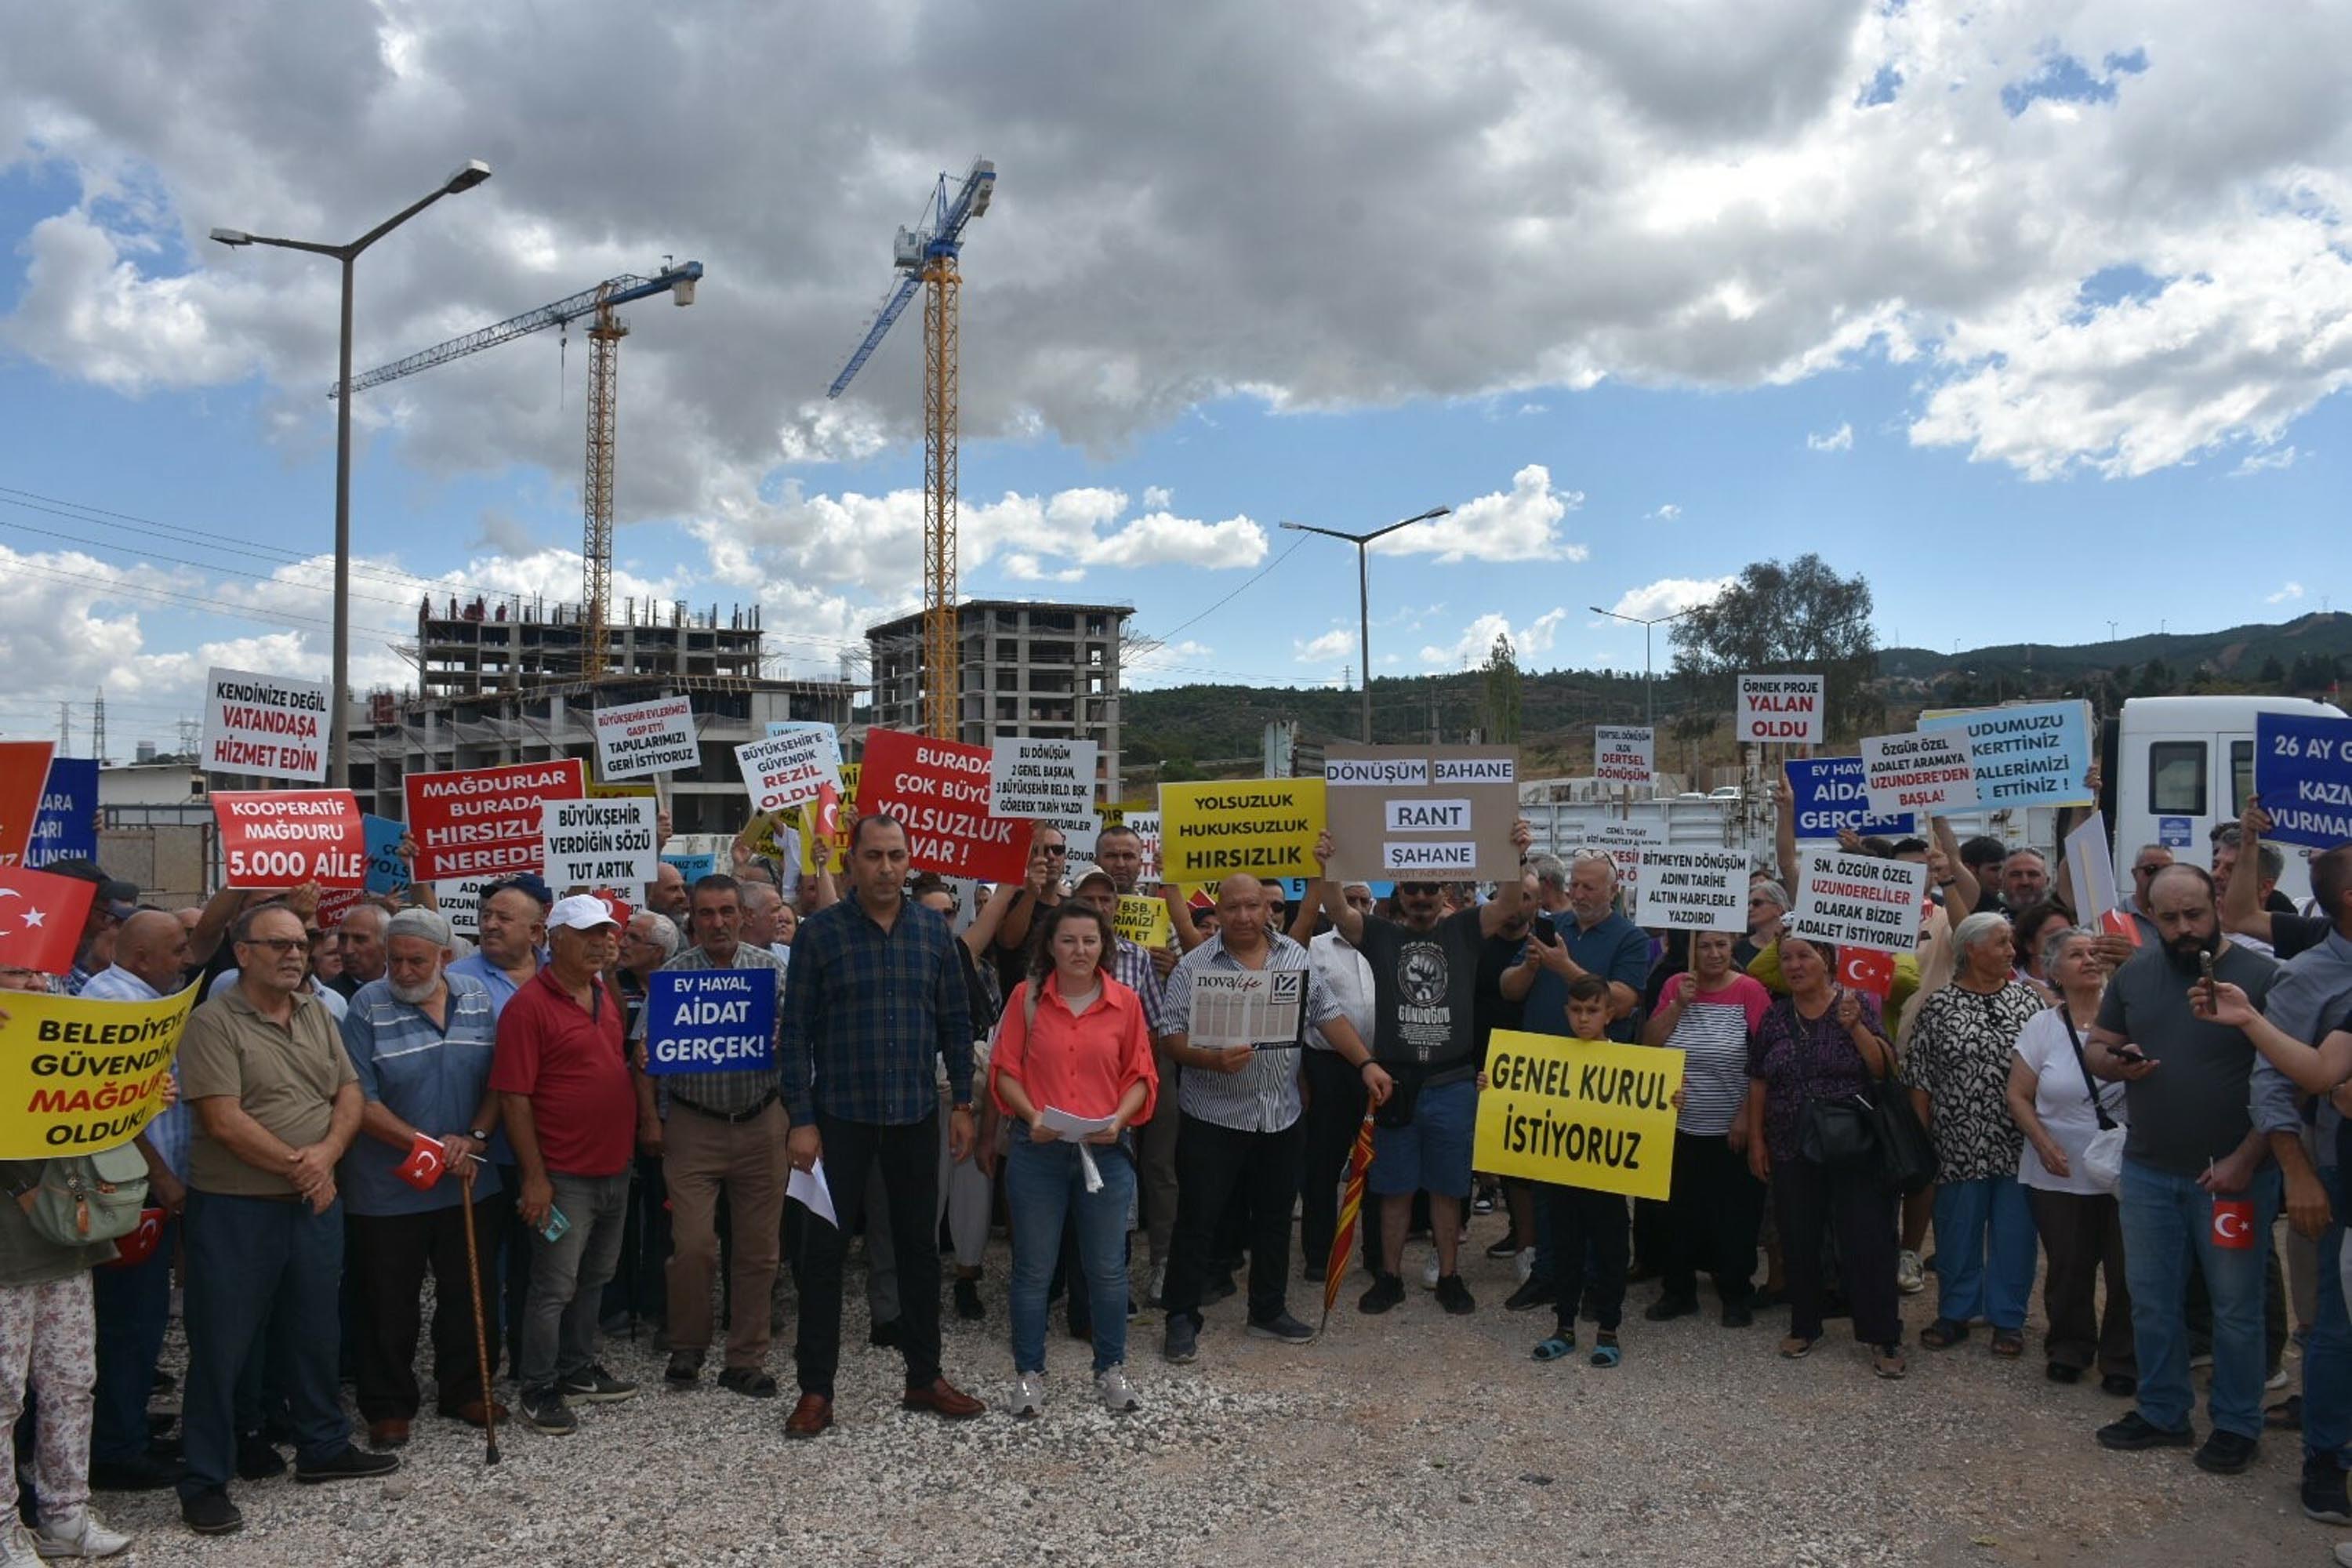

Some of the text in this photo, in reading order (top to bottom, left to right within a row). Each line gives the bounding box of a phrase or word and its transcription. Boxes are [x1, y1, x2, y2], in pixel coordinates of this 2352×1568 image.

[216, 682, 326, 712] KENDİNİZE DEĞİL
[1743, 679, 1819, 693] ÖRNEK PROJE
[597, 701, 688, 727] BÜYÜKŞEHİR EVLERİMİZİ
[1747, 695, 1813, 712] YALAN
[223, 706, 317, 740] VATANDAŞA
[626, 720, 665, 737] GASP ETTİ
[1751, 720, 1807, 737] OLDU
[1968, 714, 2063, 737] UDUMUZU
[215, 735, 318, 771] HİZMET EDİN
[608, 731, 686, 754] TAPULARIMIZI
[742, 732, 823, 760] BÜYÜKŞEHİR'E
[1020, 744, 1070, 760] BU DÖNÜŞÜM
[1882, 738, 1949, 756] ÖZGÜR ÖZEL
[2274, 735, 2299, 757] 26
[2306, 738, 2333, 760] AY
[608, 749, 694, 772] GERİ İSTİYORUZ
[757, 749, 817, 772] GÜVENDİK
[916, 746, 992, 774] BURADA
[1011, 764, 1017, 775] 2
[1017, 764, 1041, 776] GENEL
[1602, 753, 1645, 766] DERTSEL
[1812, 764, 1864, 776] EV HAY
[1871, 753, 1965, 777] ADALET ARAMAYA
[763, 764, 822, 789] REZİL
[1326, 761, 1512, 783] DÖNÜŞÜM BAHANE
[1598, 768, 1650, 782] DÖNÜŞÜM
[1871, 768, 1969, 789] UZUNDERE'DEN
[423, 771, 567, 797] MAĞDURLAR
[895, 774, 991, 805] ÇOK BÜYÜ
[996, 782, 1000, 793] 3
[1002, 779, 1049, 797] BÜYÜKŞEHİR
[1813, 779, 1868, 801] AİDA
[1993, 777, 2057, 799] ETTİNİZ
[230, 798, 346, 815] KOOPERATİF
[450, 795, 543, 817] BURADA
[1000, 797, 1082, 814] GÖREREK TARİH YAZDI
[1194, 793, 1294, 811] YOLSUZLUK
[1899, 789, 1945, 811] BAŞLA!
[559, 803, 641, 829] BÜYÜKŞEHİR
[877, 799, 1013, 844] YOLSUZLUK
[1179, 818, 1308, 837] HUKUKSUZLUK
[1398, 807, 1463, 826] RANT
[2267, 807, 2352, 838] VURMA
[245, 819, 345, 840] MAĞDURU
[550, 829, 650, 854] VERDİĞİN SÖZÜ
[911, 835, 955, 864] VAR
[230, 846, 362, 878] 5.000 AİLE
[1186, 846, 1301, 869] HIRSIZLIK
[1391, 848, 1471, 867] ŞAHANE
[1642, 850, 1746, 872] BİTMEYEN DÖNÜŞÜM
[568, 861, 634, 880] TUT ARTIK
[1661, 873, 1726, 887] ADINI TARİHE
[1814, 858, 1913, 885] SN. ÖZGÜR ÖZEL
[1649, 891, 1736, 907] ALTIN HARFLERLE
[1812, 879, 1911, 906] UZUNDERELİLER
[1113, 913, 1154, 927] RİMİZİ
[1668, 910, 1715, 924] YAZDIRDI
[1814, 901, 1902, 925] OLARAK BİZDE
[1797, 919, 1914, 949] ADALET İSTİYORUZ!
[673, 976, 752, 993] EV HAYAL,
[673, 996, 752, 1026] AİDAT
[31, 1038, 173, 1077] GÜVENDİK
[655, 1035, 765, 1065] GERÇEK!
[1492, 1053, 1668, 1111] GENEL KURUL
[45, 1107, 146, 1146] OLDUK!
[1504, 1103, 1642, 1169] İSTİYORUZ
